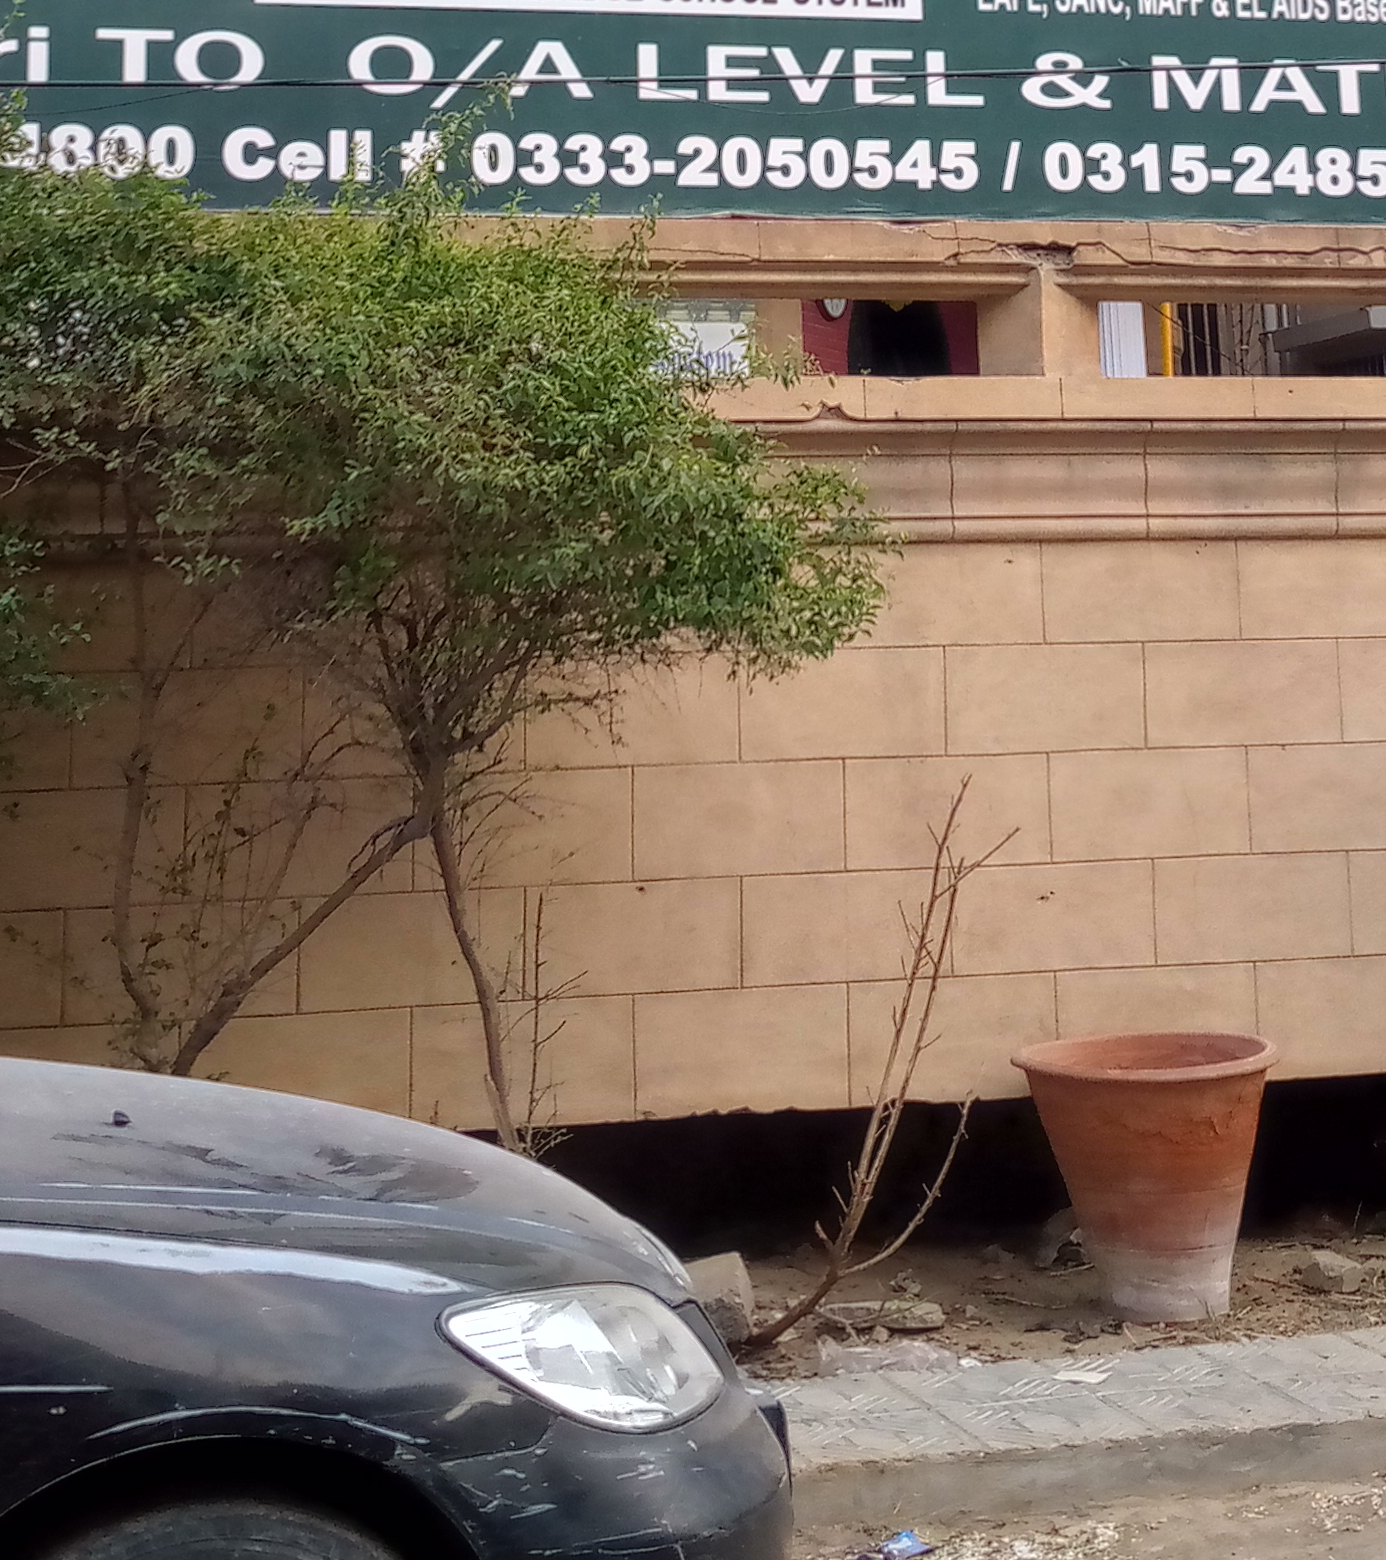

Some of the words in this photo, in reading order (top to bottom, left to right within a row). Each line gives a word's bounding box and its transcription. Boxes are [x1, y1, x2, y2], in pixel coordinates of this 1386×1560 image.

[95, 28, 264, 90] TO
[347, 34, 595, 110] O/A
[636, 42, 986, 107] LEVEL
[1020, 51, 1112, 110] &
[221, 126, 373, 183] Cell
[471, 130, 980, 192] 0333-2050545
[1002, 141, 1021, 192] /
